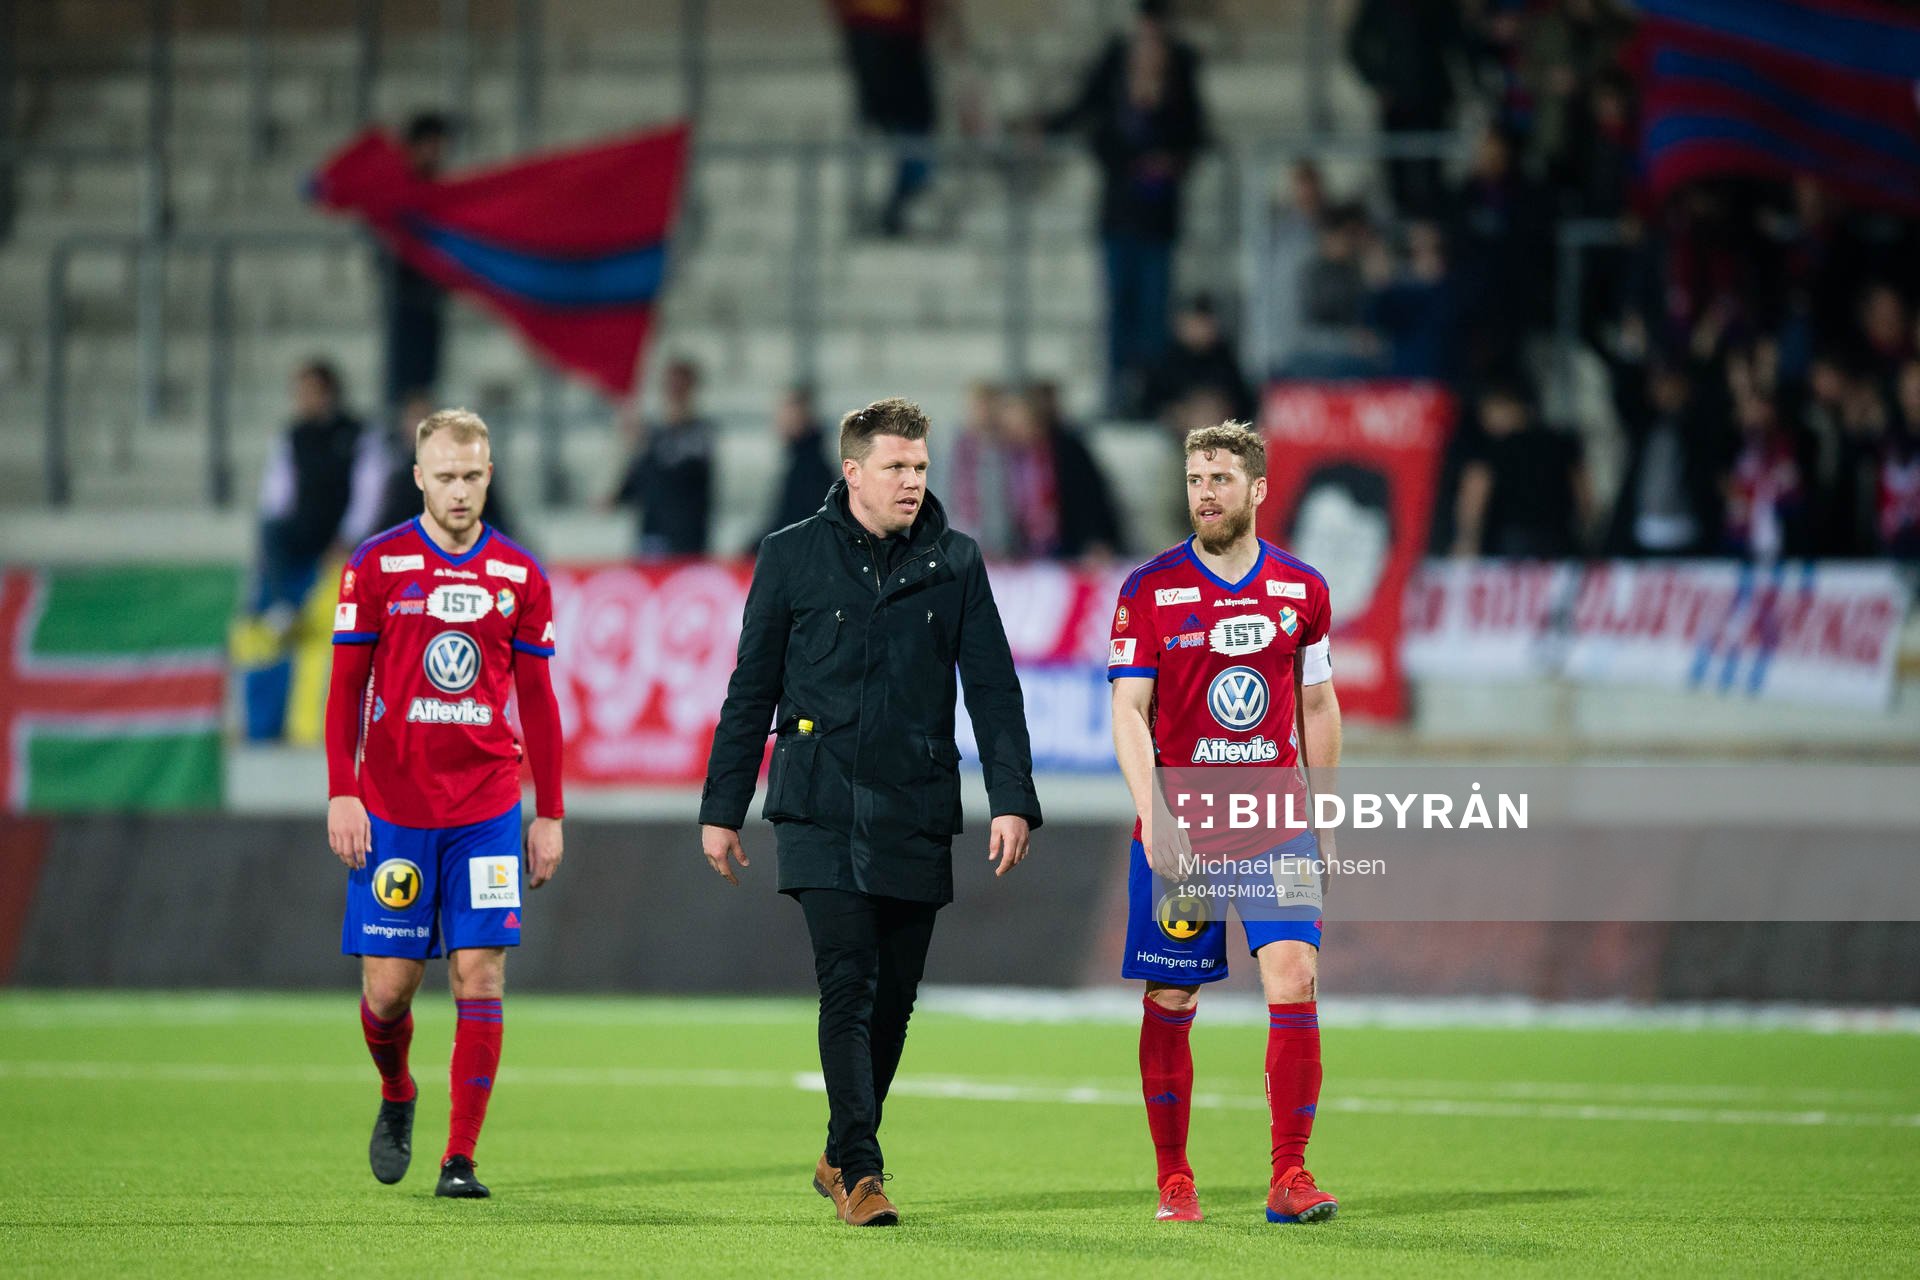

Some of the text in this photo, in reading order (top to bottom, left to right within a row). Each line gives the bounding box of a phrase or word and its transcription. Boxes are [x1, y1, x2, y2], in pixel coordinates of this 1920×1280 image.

[442, 592, 482, 614] IST
[1224, 622, 1265, 647] IST
[408, 699, 491, 725] Atteviks
[1193, 736, 1278, 763] Atteviks
[1137, 951, 1215, 969] Holmgrens Bil
